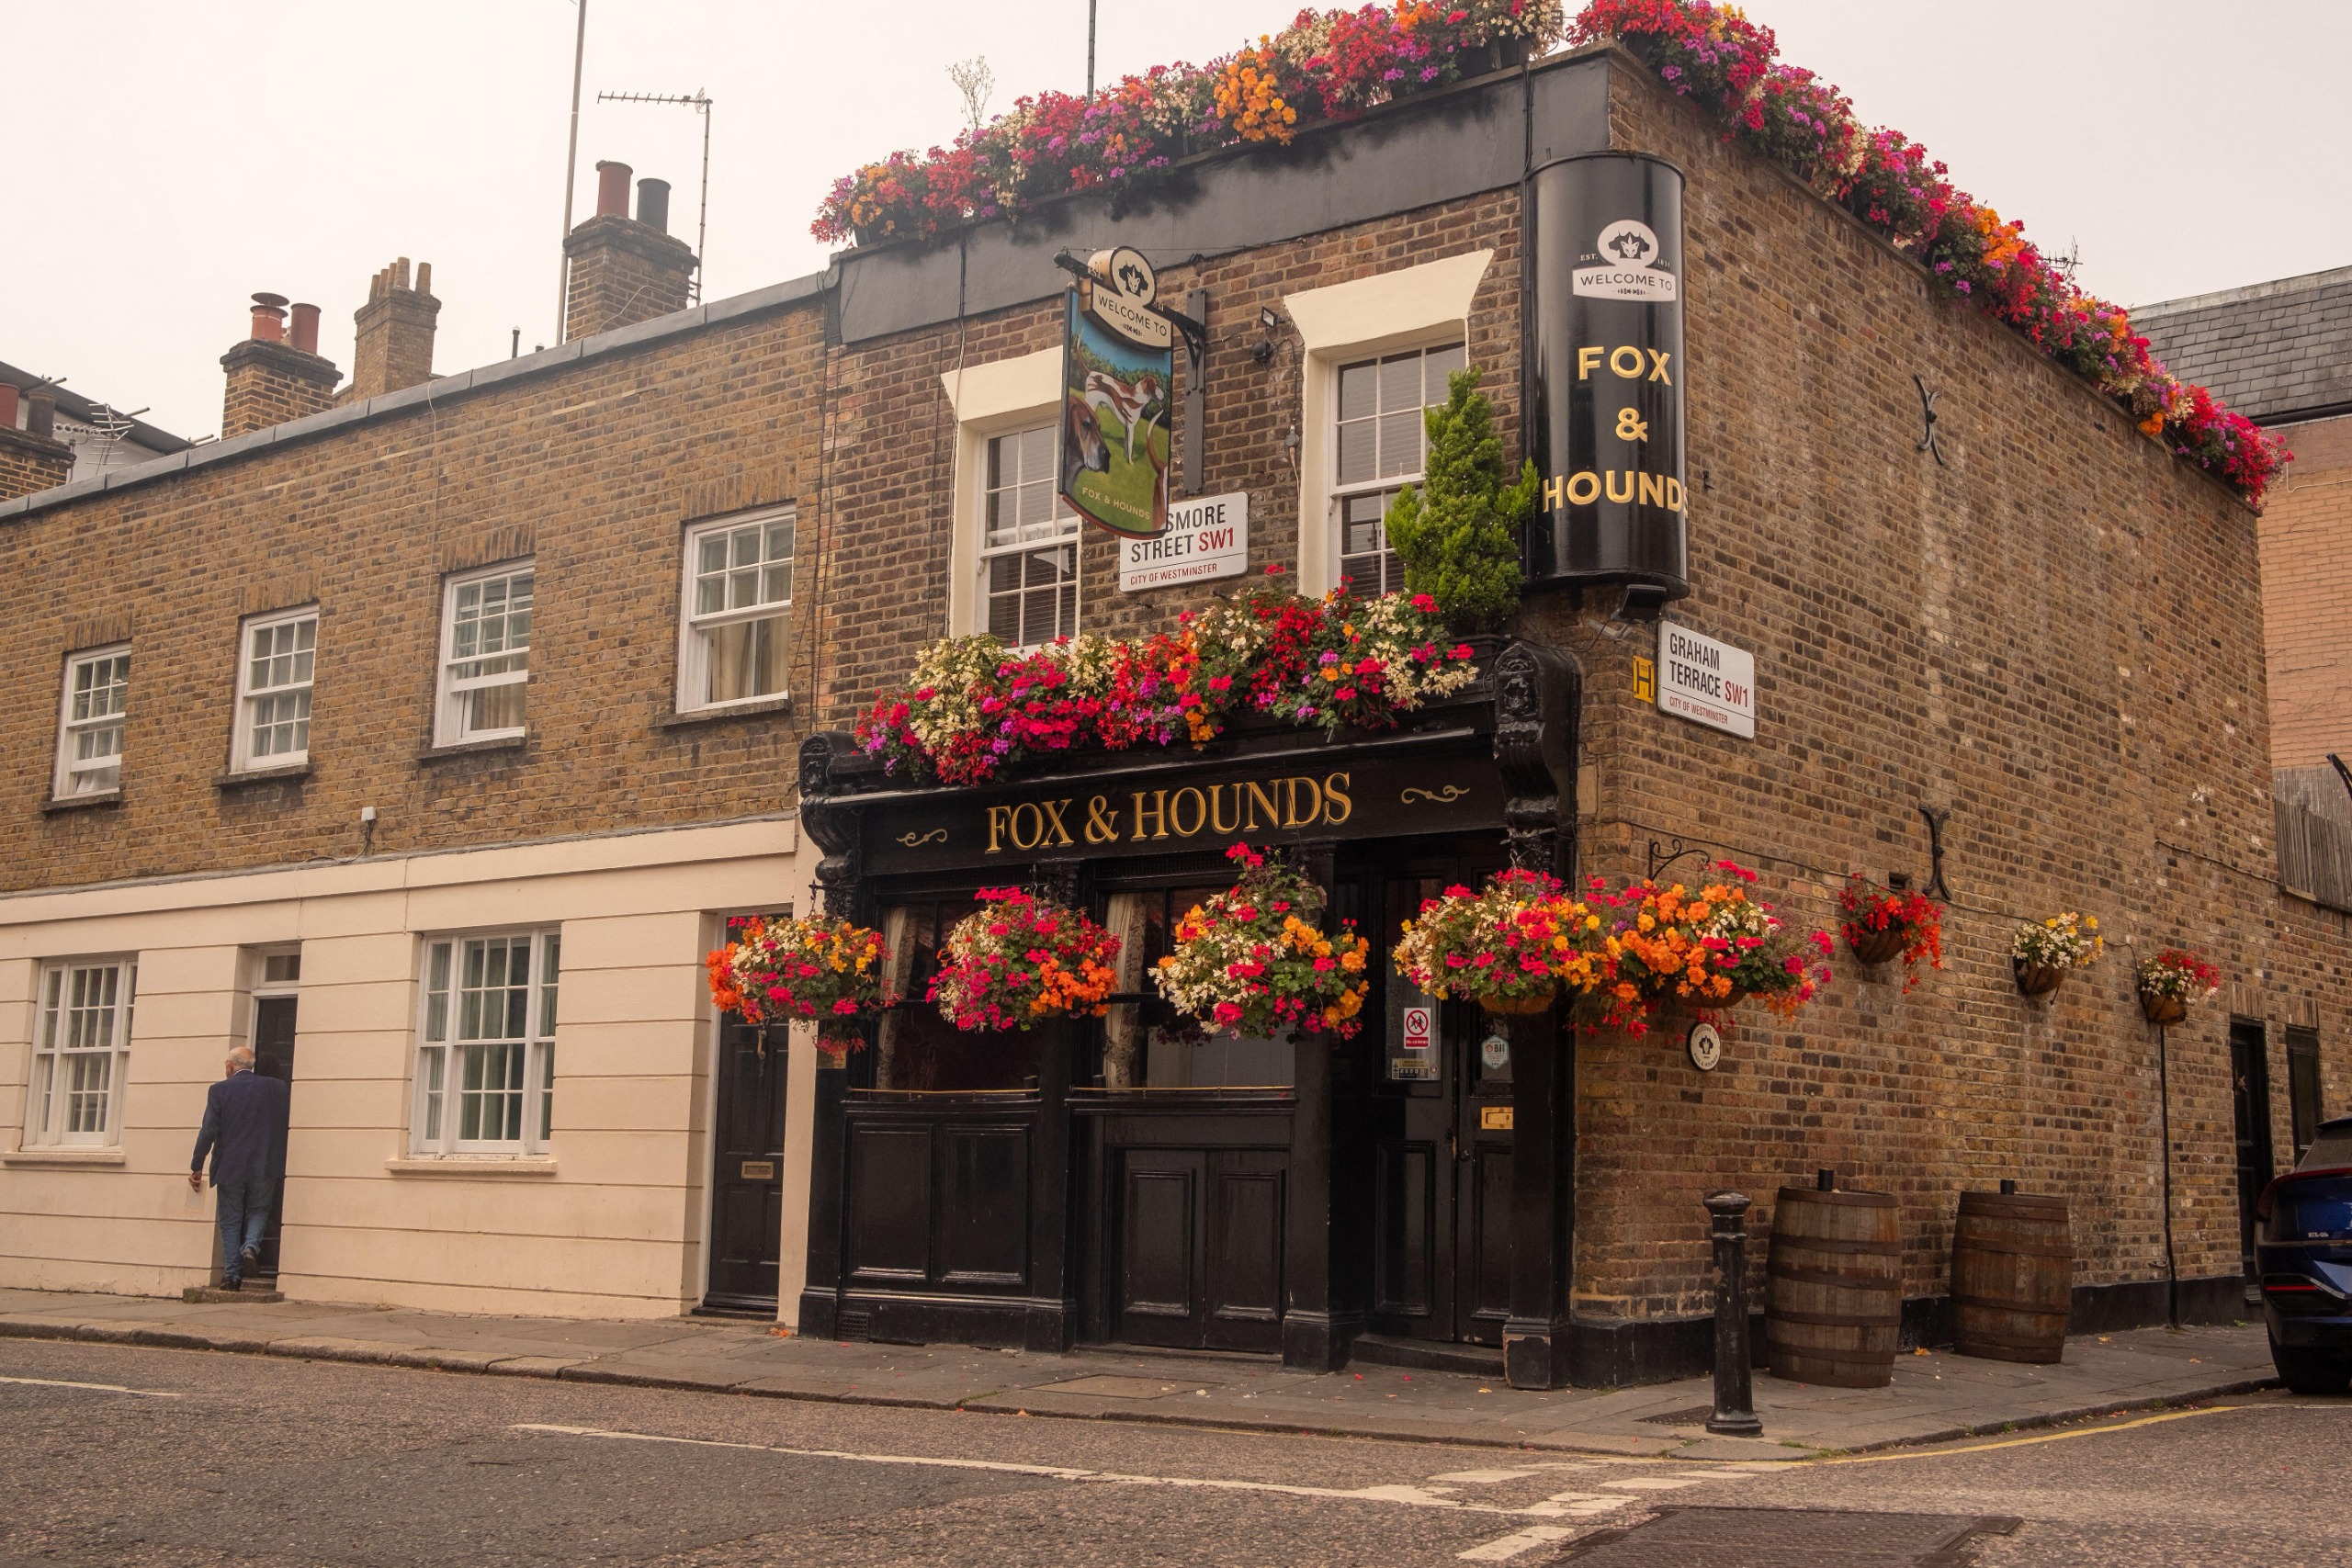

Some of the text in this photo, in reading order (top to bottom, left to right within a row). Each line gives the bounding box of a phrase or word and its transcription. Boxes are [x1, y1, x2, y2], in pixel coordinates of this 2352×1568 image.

[1580, 253, 1599, 262] EST.
[1657, 258, 1670, 268] 1831
[1580, 274, 1672, 291] WELCOME TO
[1098, 294, 1167, 336] WELCOME TO
[1578, 345, 1672, 386] FOX
[1615, 407, 1648, 443] &
[1082, 486, 1151, 520] FOX & HOUNDS
[1543, 469, 1689, 519] HOUNDS
[1166, 503, 1227, 533] SMORE
[1131, 527, 1234, 563] STREET SW1
[1130, 563, 1218, 586] CITY OF WESTMINSTER
[1669, 632, 1720, 671] GRAHAM
[1669, 660, 1748, 708] TERRACE SW1
[1669, 695, 1728, 725] CITY OF WESTMINSTER
[985, 772, 1352, 855] FOX & HOUNDS
